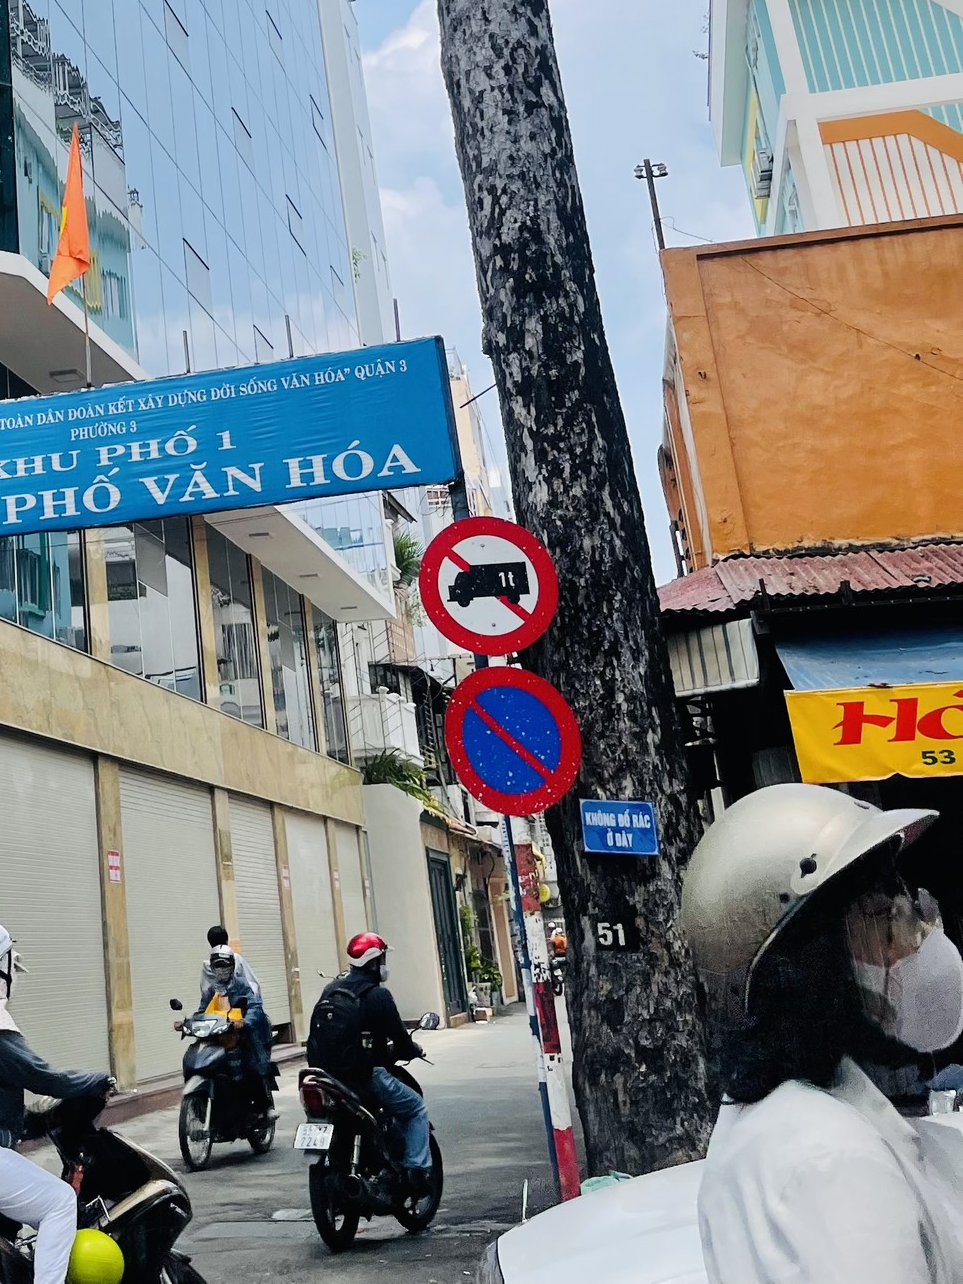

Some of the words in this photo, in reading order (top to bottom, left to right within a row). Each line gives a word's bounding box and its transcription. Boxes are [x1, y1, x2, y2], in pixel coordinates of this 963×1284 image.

[36, 407, 66, 426] DÂN
[68, 402, 106, 421] ĐOÀN
[107, 395, 135, 415] KẾT
[137, 393, 164, 411] XÂY
[167, 389, 207, 408] DỰNG
[210, 382, 236, 401] ĐỜI
[239, 376, 278, 397] SỐNG
[280, 372, 311, 391] VĂN
[354, 359, 397, 381] QUẬN
[399, 359, 408, 372] 3
[70, 421, 126, 441] PHƯỜNG
[129, 420, 138, 434] 3
[95, 424, 198, 467] PHỐ
[216, 430, 237, 451] 1
[1, 467, 122, 525] PHỐ
[138, 461, 265, 506] VĂN
[283, 439, 422, 489] HÓA
[498, 571, 515, 587] 1t
[921, 749, 956, 765] 53
[585, 810, 616, 827] KHÔNG
[632, 812, 651, 828] RÁC
[614, 831, 633, 848] ĐÂY
[597, 922, 626, 946] 51
